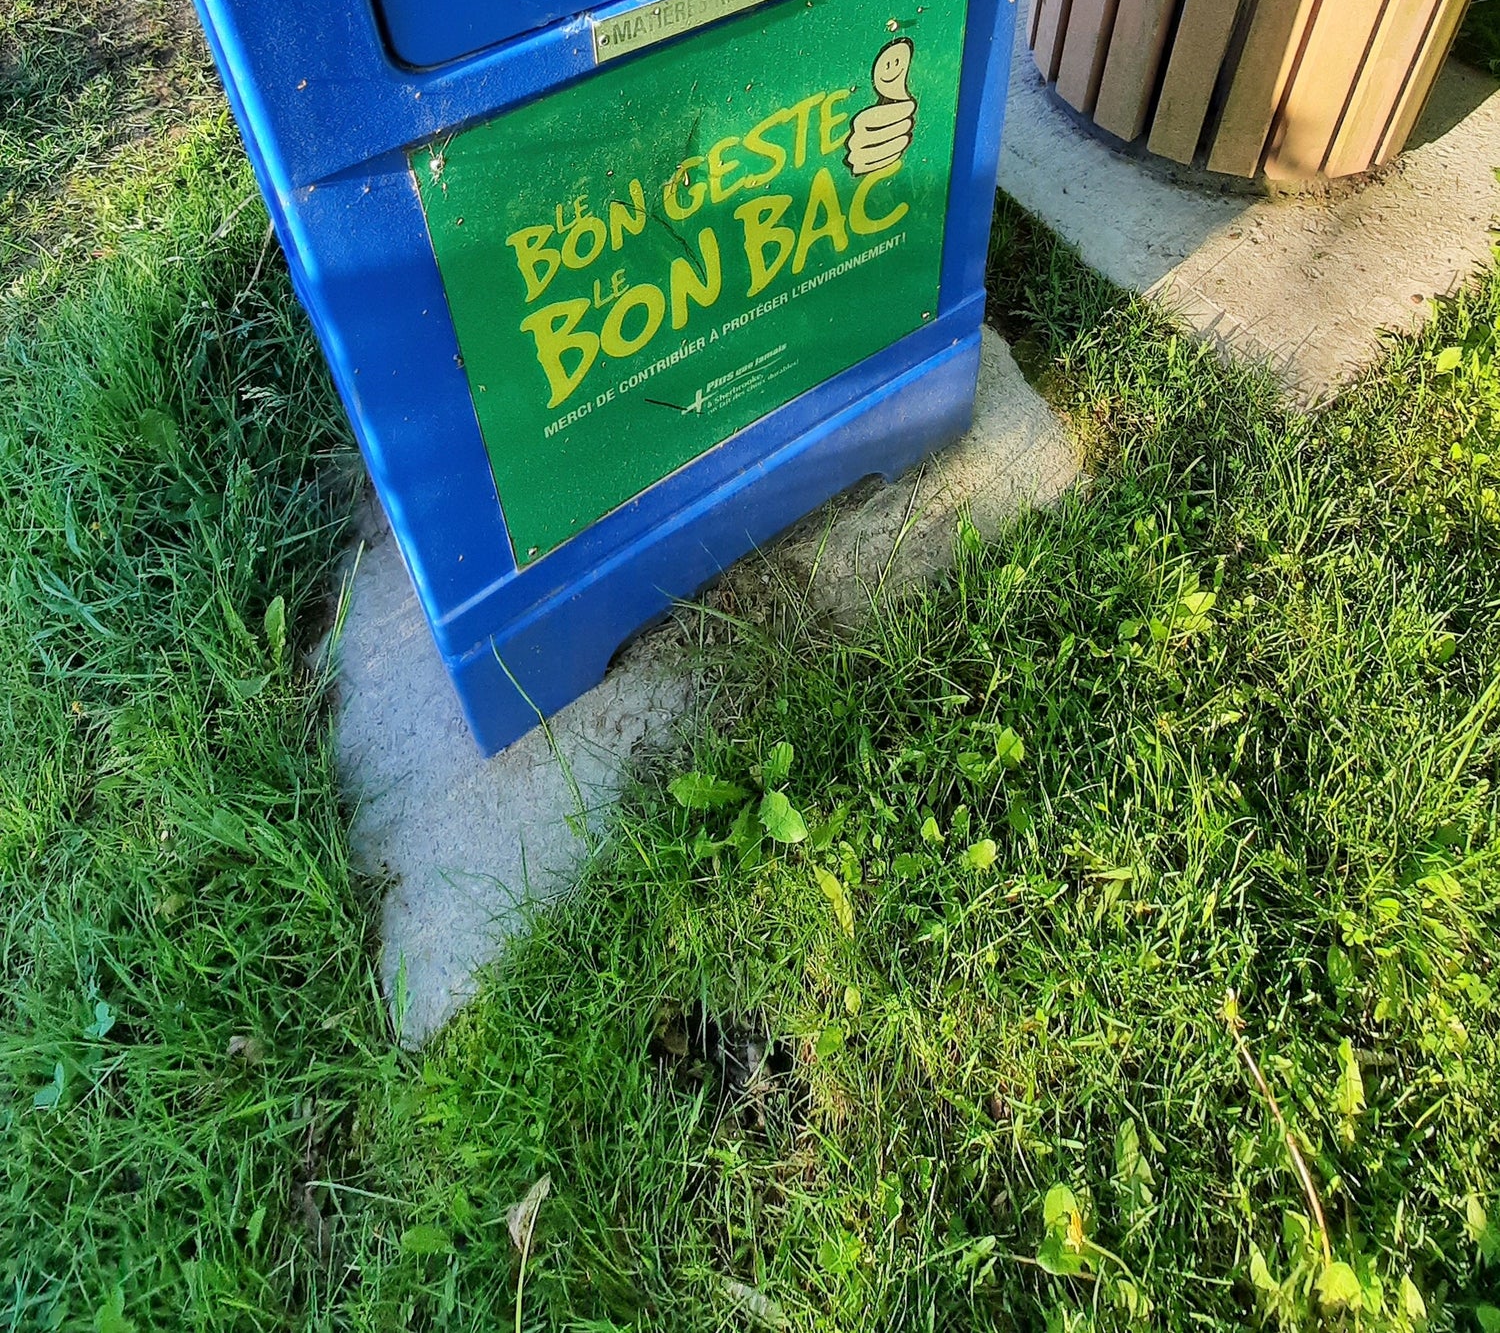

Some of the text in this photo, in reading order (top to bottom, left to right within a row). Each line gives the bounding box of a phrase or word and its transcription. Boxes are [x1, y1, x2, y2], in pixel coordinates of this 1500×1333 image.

[506, 89, 850, 303] LE BON GESTE
[520, 161, 909, 409] LE BON BAC
[544, 402, 592, 438] MERCI
[596, 389, 616, 407] DE
[619, 337, 706, 392] CONTRIBUER
[709, 328, 720, 344] À
[722, 293, 789, 337] PROTÉGER
[706, 371, 735, 393] Plus
